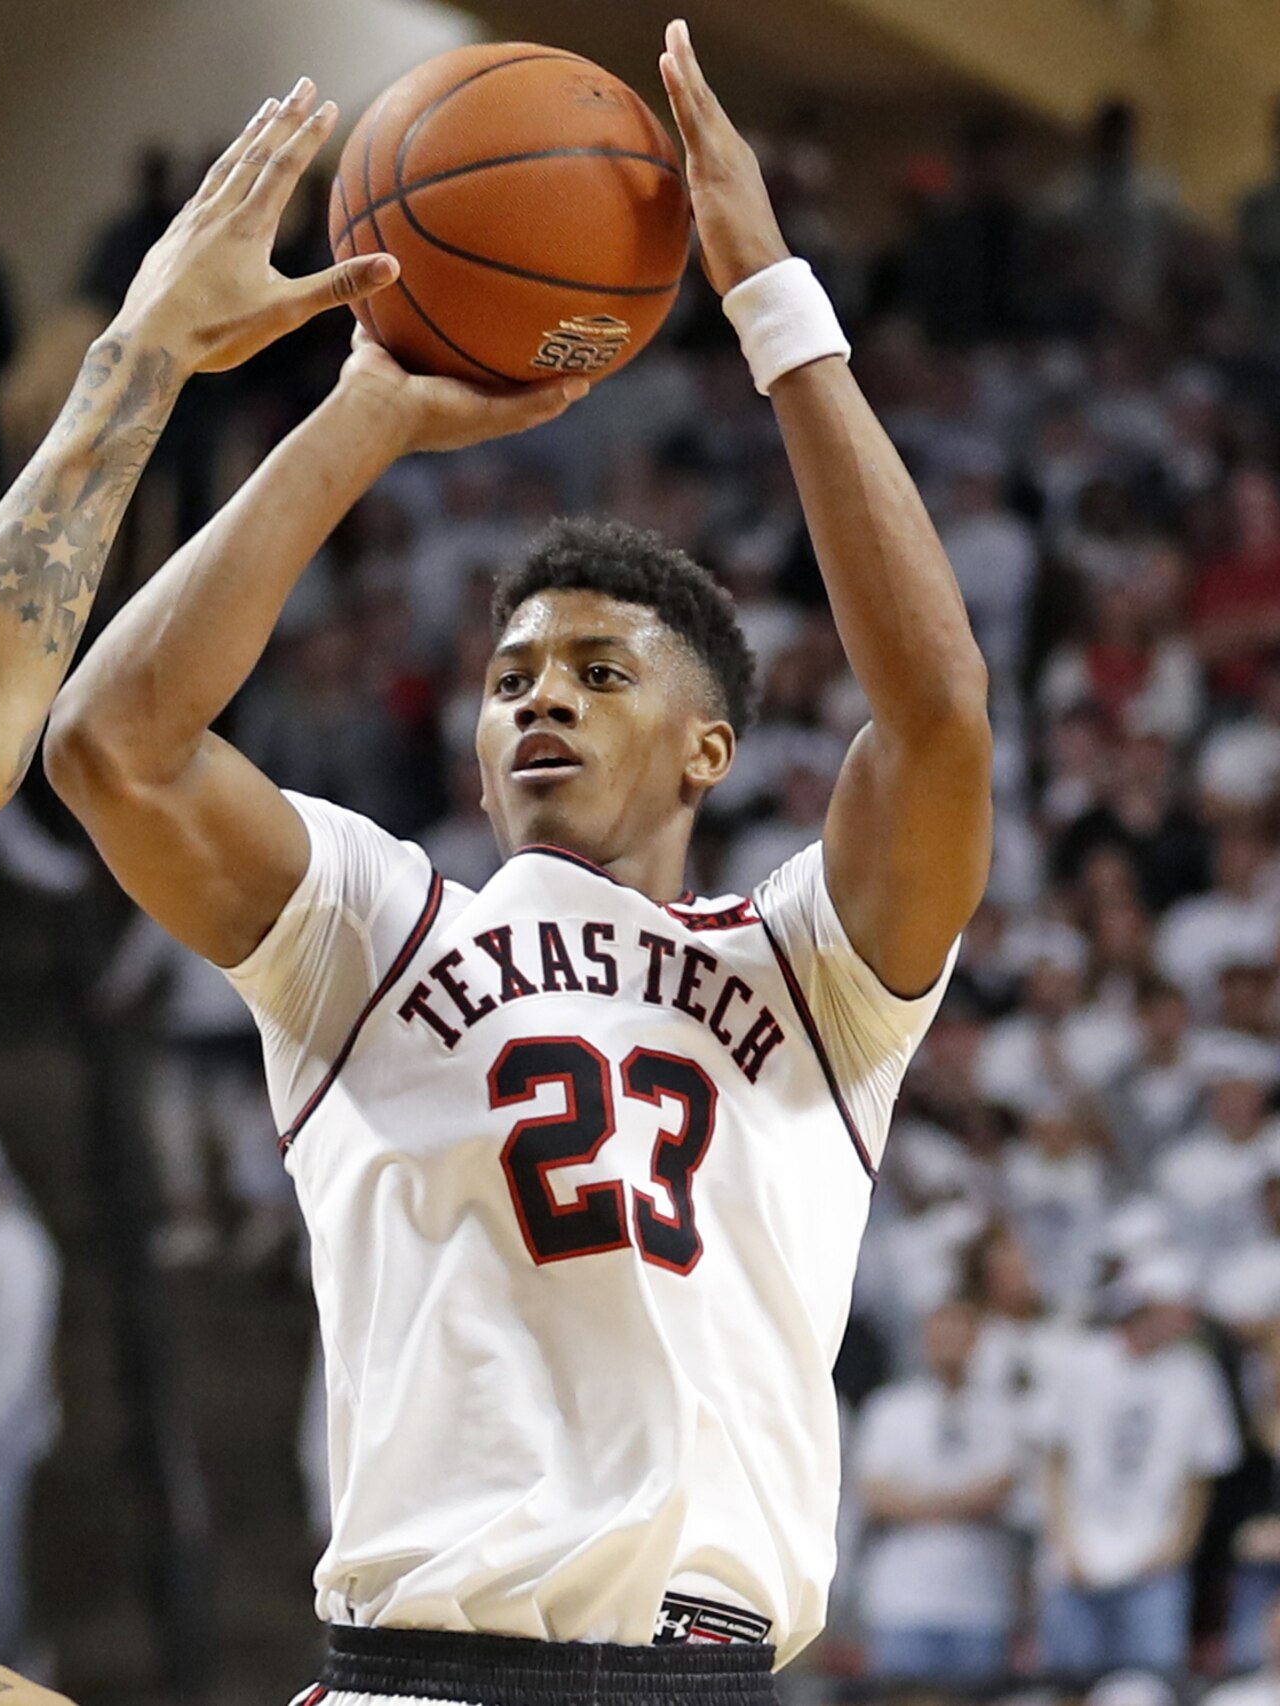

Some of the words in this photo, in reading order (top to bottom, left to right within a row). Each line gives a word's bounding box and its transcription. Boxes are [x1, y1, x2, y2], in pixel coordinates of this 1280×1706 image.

[397, 920, 619, 1050] TEXAS
[639, 929, 786, 1085] TECH
[486, 1035, 719, 1277] 23
